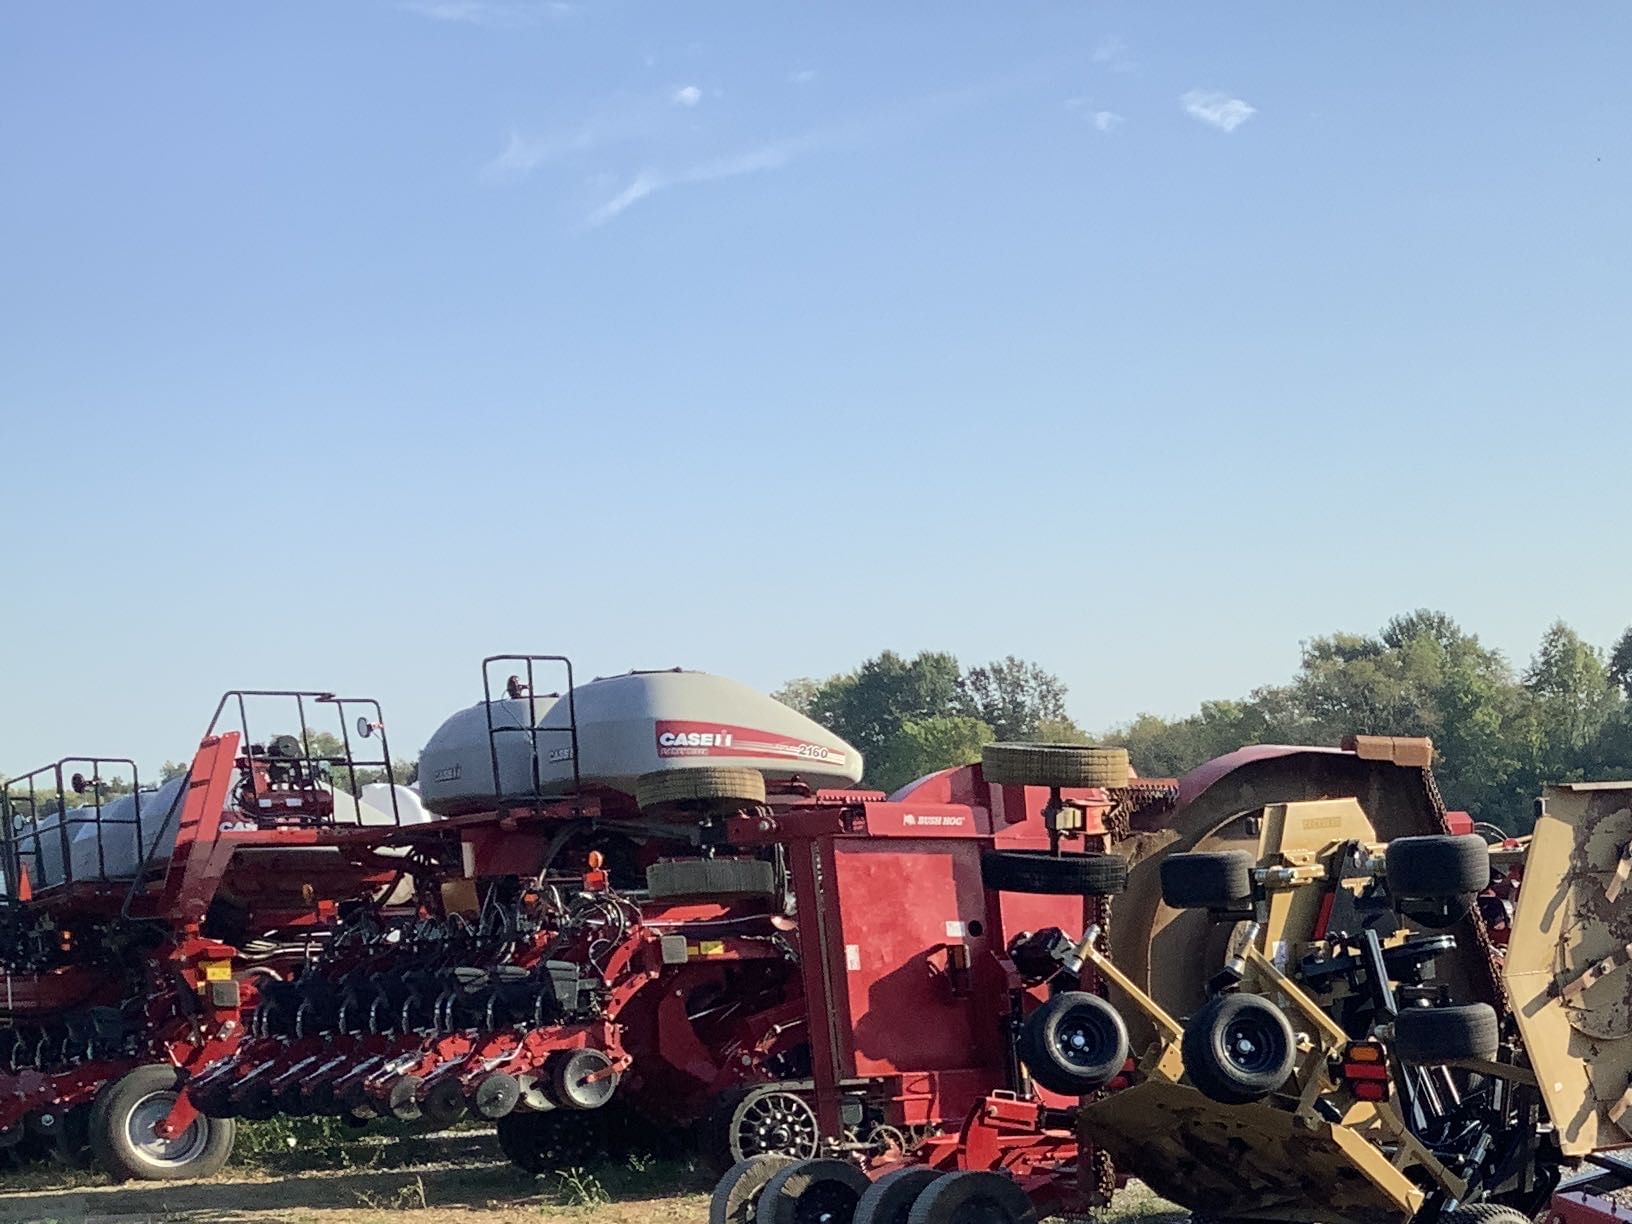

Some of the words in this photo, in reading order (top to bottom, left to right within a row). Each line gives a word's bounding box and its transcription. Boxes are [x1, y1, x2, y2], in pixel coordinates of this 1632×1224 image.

[799, 743, 828, 759] 2160
[917, 815, 940, 826] BUSH
[942, 816, 962, 826] HOG
